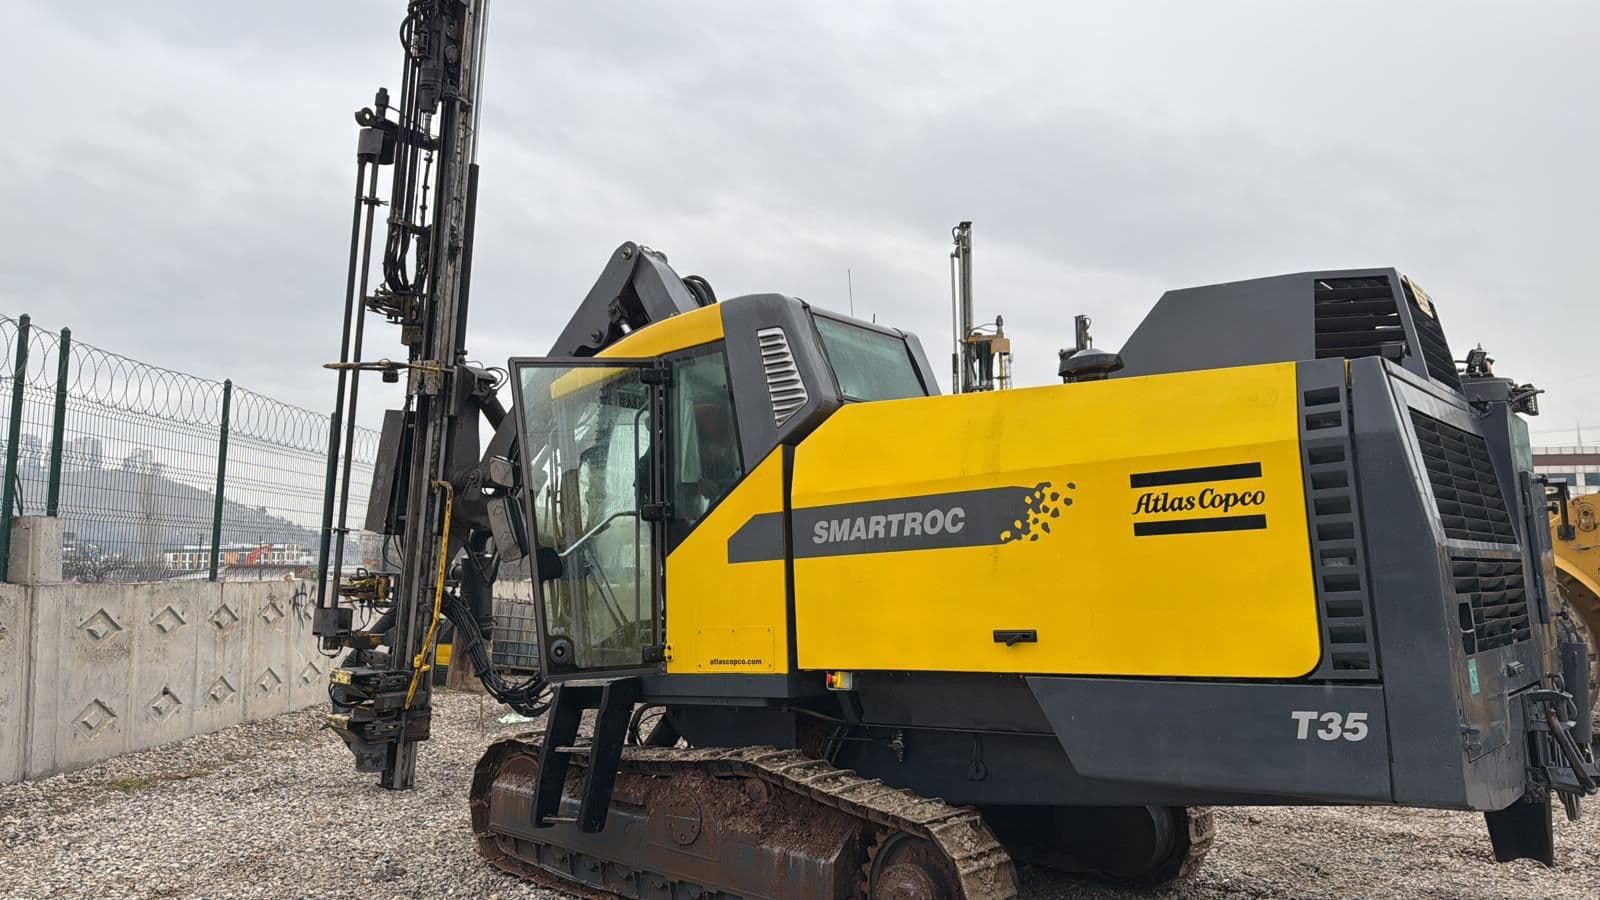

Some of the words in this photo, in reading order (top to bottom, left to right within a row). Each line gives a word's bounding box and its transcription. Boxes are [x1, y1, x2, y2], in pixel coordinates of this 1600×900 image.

[1132, 492, 1195, 515] Atlas
[1199, 488, 1265, 512] Copco
[812, 507, 966, 544] SMARTROC
[709, 658, 762, 666] atlascopco.com
[1291, 711, 1369, 741] T35
